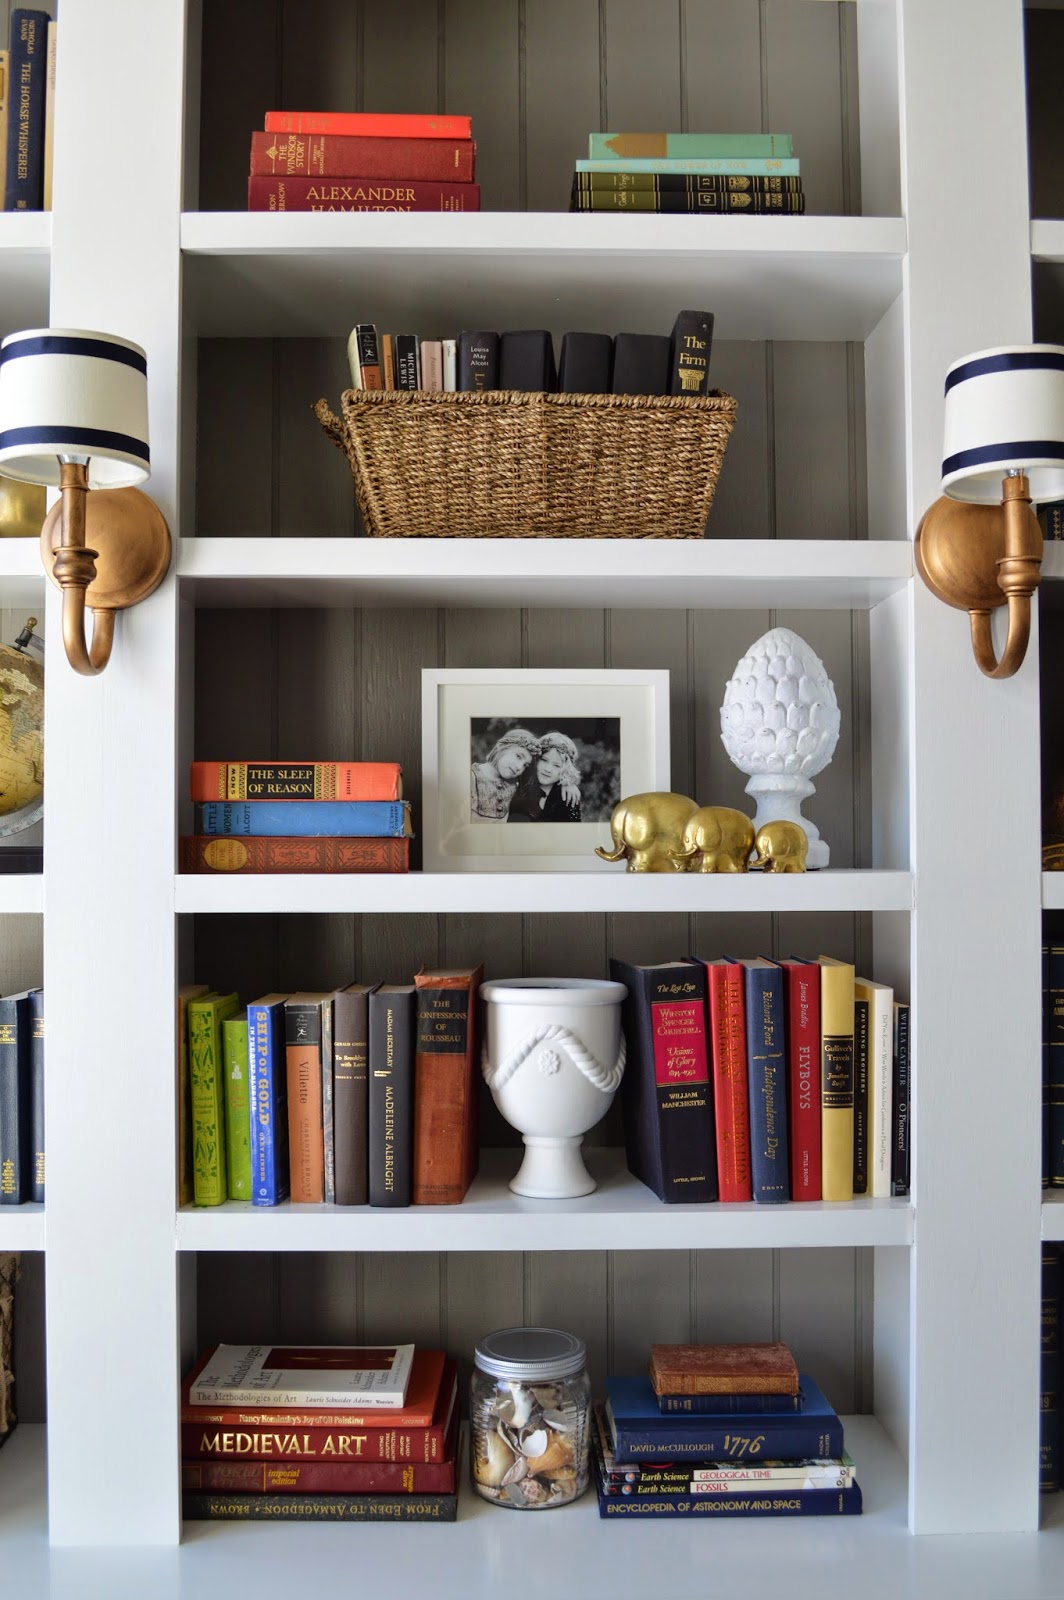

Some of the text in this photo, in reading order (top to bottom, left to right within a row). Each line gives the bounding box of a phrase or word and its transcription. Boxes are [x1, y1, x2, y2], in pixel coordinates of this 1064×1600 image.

[21, 19, 29, 41] EVANS
[27, 20, 36, 54] NICHOLAS
[18, 63, 31, 180] THE HORSE WHISPERER
[279, 145, 288, 161] THE
[287, 135, 297, 175] WINDSOR
[296, 140, 305, 168] STORY
[702, 177, 711, 186] 13
[306, 186, 417, 202] ALEXANDER
[703, 194, 712, 204] 47
[684, 335, 707, 350] The
[472, 353, 487, 361] May
[678, 352, 707, 369] Firm
[400, 358, 408, 385] LEWIS
[407, 352, 417, 390] MICHAEL
[248, 769, 313, 780] THE SLEEP
[248, 783, 313, 794] OF REASON
[208, 803, 218, 834] LITTLE
[223, 803, 232, 834] WOMEN
[243, 804, 251, 834] ALCOTT
[657, 984, 669, 993] The
[669, 984, 682, 994] Last
[432, 1000, 450, 1008] THE
[800, 982, 810, 1029] James Bradley
[417, 1011, 467, 1019] CONFESSIONS
[763, 991, 775, 1046] Richard Ford
[250, 1026, 256, 1035] IN
[657, 1026, 702, 1036] CHURCHILL
[420, 1034, 461, 1042] ROUSSEAU
[718, 1018, 731, 1078] BROKAW
[824, 1044, 853, 1052] Gulliver's
[256, 1011, 270, 1126] SHIP OF GOLD
[666, 1056, 696, 1069] of Glory
[298, 1060, 309, 1105] Villette
[729, 980, 749, 1185] THE GREATEST GENERATION
[799, 1046, 811, 1109] FLYBOYS
[669, 1091, 698, 1100] WILLIAM
[661, 1100, 706, 1109] MANCHESTER
[762, 1066, 779, 1160] Independence Day
[898, 1103, 907, 1151] O Pioneers!
[304, 1118, 312, 1164] CHARLOTTE
[385, 1086, 394, 1192] MADELEINE ALBRIGHT
[221, 1346, 263, 1389] Methodologies
[196, 1376, 220, 1388] The
[196, 1391, 298, 1404] The Methodologies of Art
[325, 1396, 352, 1404] Schneider
[353, 1397, 373, 1405] Adams
[239, 1414, 364, 1426] Nancy Kominsky's Joy of Oil Painting
[200, 1432, 367, 1456] MEDIEVAL ART
[630, 1443, 715, 1453] DAVID McCULLOUGH
[724, 1434, 766, 1458] 1776
[268, 1469, 300, 1478] imperial
[640, 1472, 690, 1482] Earth Science
[700, 1470, 771, 1480] GEOLOGICAL TIME
[271, 1477, 298, 1486] edition
[696, 1482, 729, 1492] FOSSILS
[637, 1483, 687, 1494] Earth Science
[210, 1504, 251, 1515] BROWN
[263, 1503, 441, 1516] FROM EDEN TO ARMAGEDDON
[607, 1500, 801, 1513] ENCYCLOPEDIA OF ASTRONOMY AND SPACE
